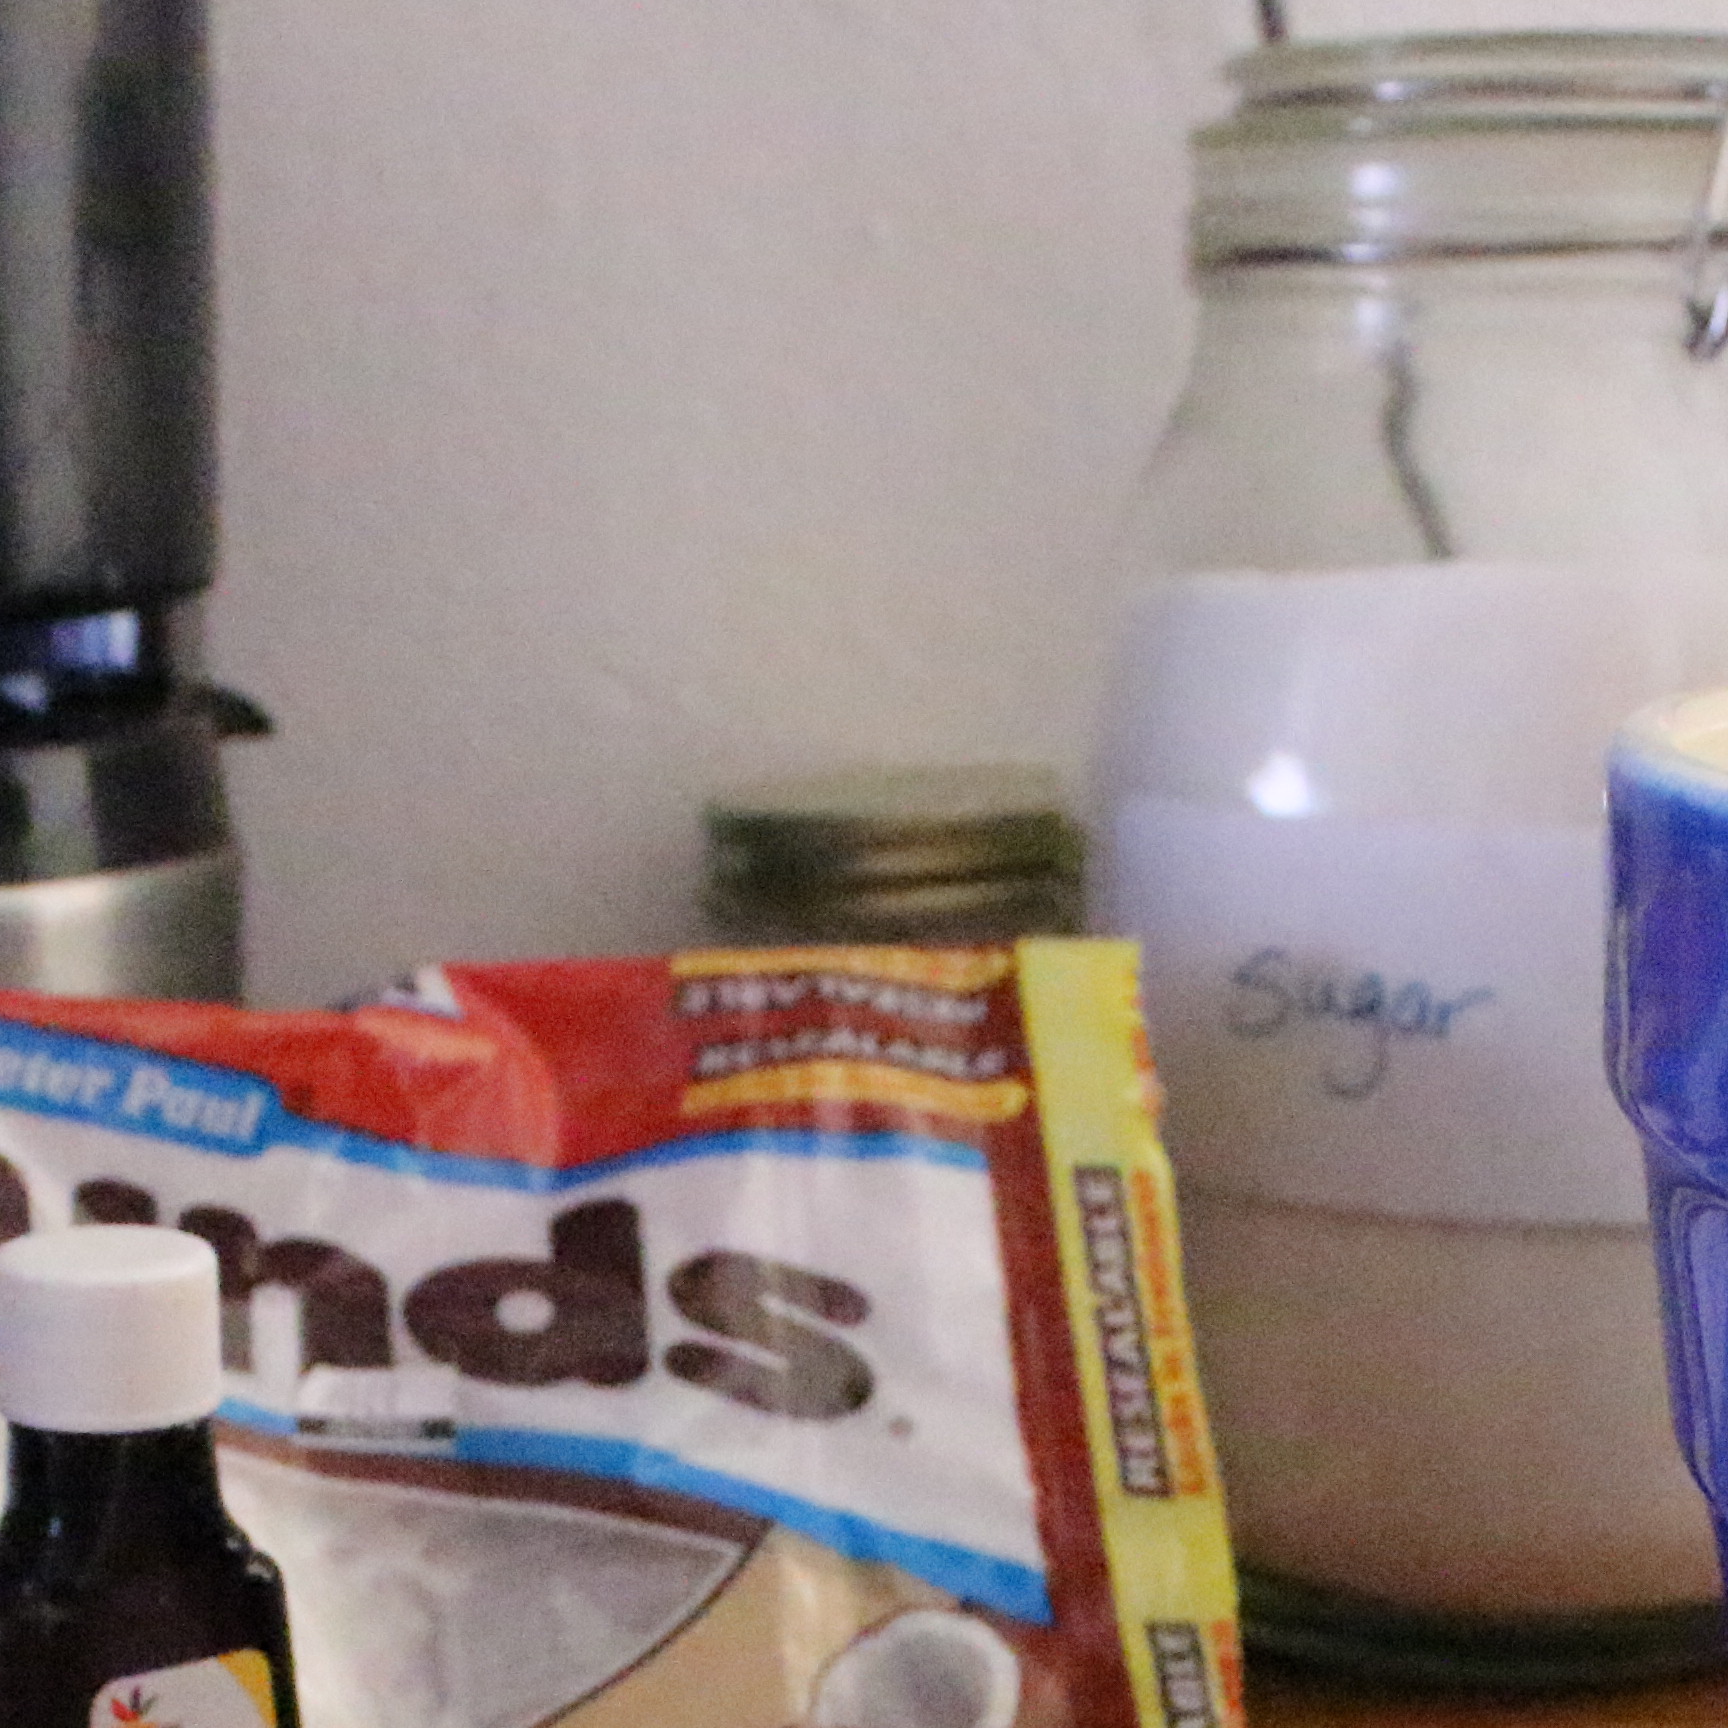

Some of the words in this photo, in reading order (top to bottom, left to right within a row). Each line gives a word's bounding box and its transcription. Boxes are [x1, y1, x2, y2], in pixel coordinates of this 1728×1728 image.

[1223, 945, 1495, 1101] Sugar
[124, 1067, 266, 1142] Paul
[1078, 1173, 1168, 1490] RESEALABLE
